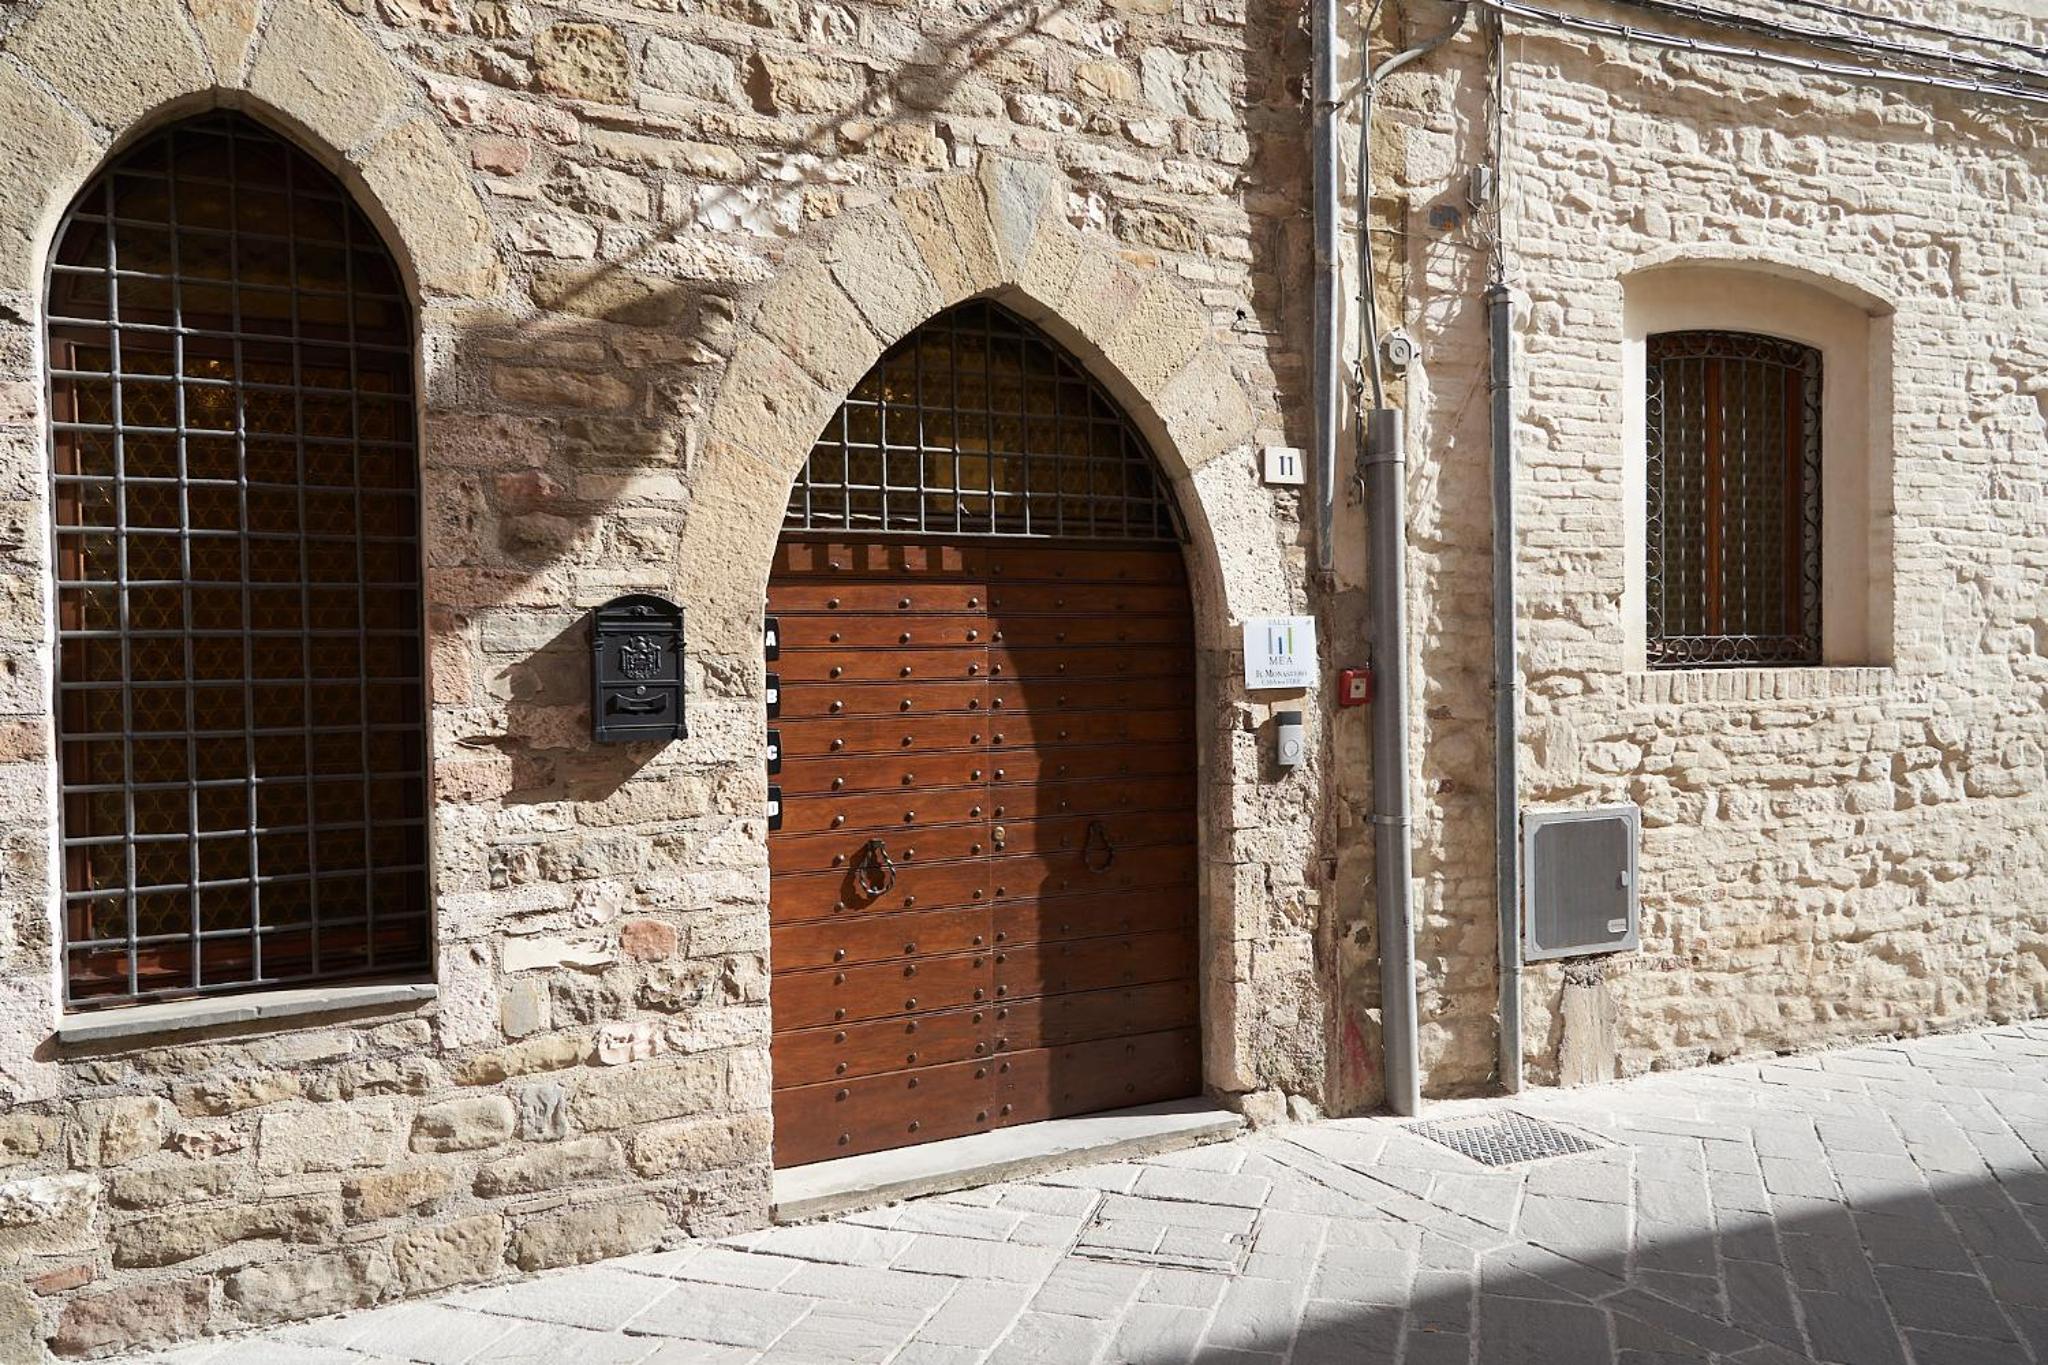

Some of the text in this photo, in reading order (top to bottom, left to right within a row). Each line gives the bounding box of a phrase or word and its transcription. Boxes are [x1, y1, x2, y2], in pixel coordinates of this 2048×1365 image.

[1279, 456, 1293, 476] 11
[765, 630, 777, 647] A
[1269, 656, 1293, 665] MEA
[766, 689, 778, 704] B
[767, 744, 778, 761] C
